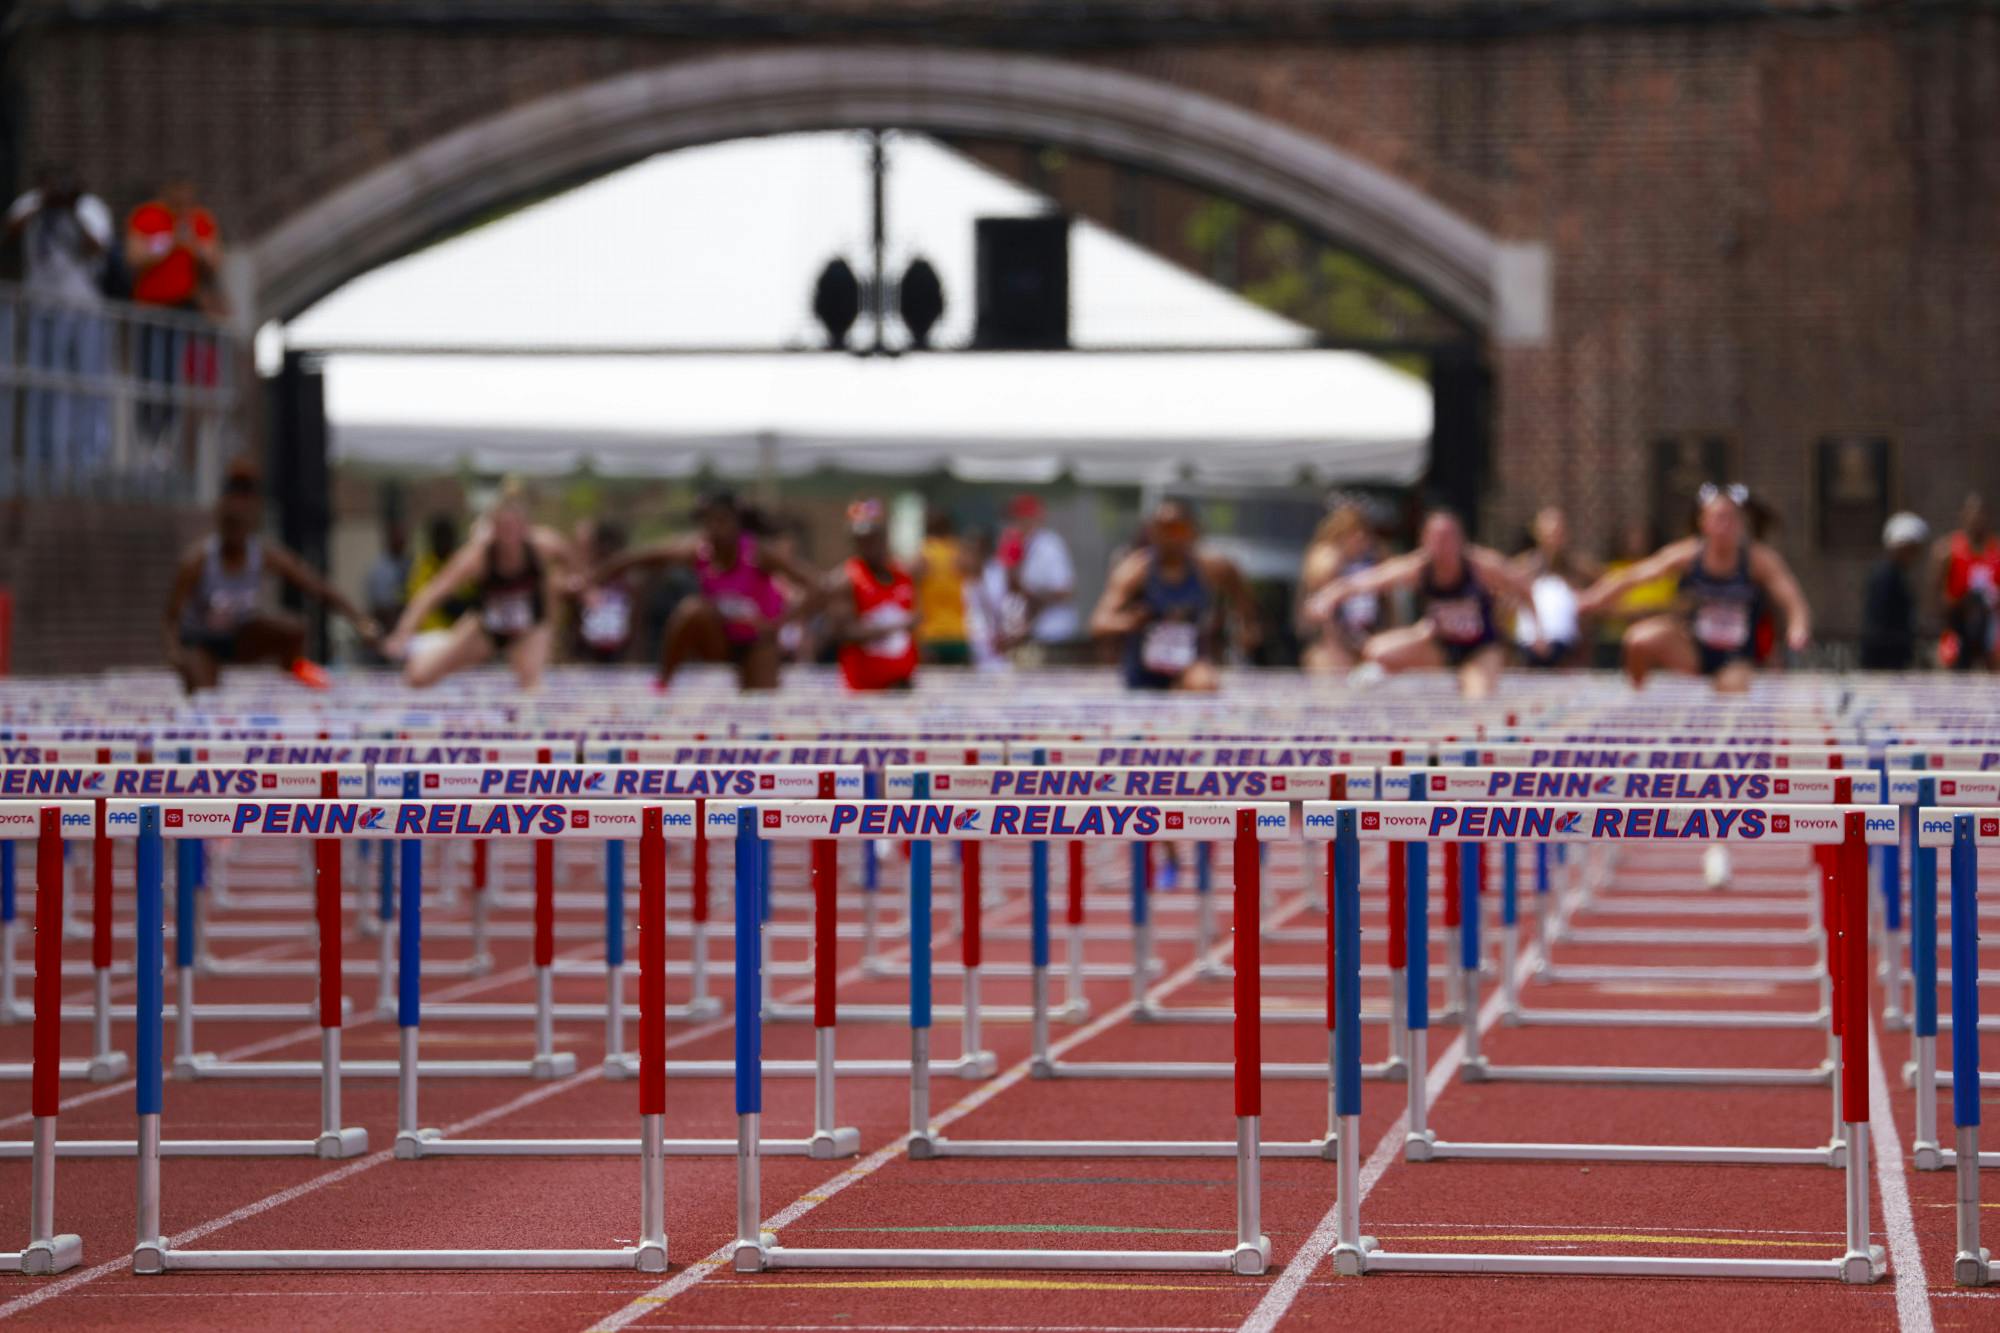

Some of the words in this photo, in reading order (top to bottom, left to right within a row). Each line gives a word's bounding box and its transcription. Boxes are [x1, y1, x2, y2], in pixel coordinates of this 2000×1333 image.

[246, 747, 333, 764] PENN
[362, 747, 481, 764] RELAYS
[673, 748, 762, 764] PENN
[790, 748, 909, 765] RELAYS
[1097, 748, 1185, 766] PENN
[1213, 748, 1334, 766] RELAYS
[1531, 750, 1620, 767] PENN
[1649, 751, 1771, 769] RELAYS
[0, 769, 83, 794] ENN
[112, 769, 258, 795] RELAYS
[280, 777, 316, 785] TOYOTA
[442, 777, 479, 786] TOYOTA
[479, 769, 584, 795] PENN
[613, 770, 756, 795] RELAYS
[779, 777, 814, 786] TOYOTA
[989, 771, 1094, 796] PENN
[1124, 771, 1267, 797] RELAYS
[1450, 779, 1486, 788] TOYOTA
[1486, 772, 1593, 798] PENN
[1624, 773, 1770, 799] RELAYS
[1793, 783, 1829, 791] TOYOTA
[1960, 784, 1996, 793] TOYOTA
[188, 813, 231, 823] TOYOTA
[231, 804, 359, 834] PENN
[394, 804, 567, 834] RELAYS
[594, 815, 637, 824] TOYOTA
[784, 815, 828, 824] TOYOTA
[829, 805, 954, 834] PENN
[990, 805, 1161, 835] RELAYS
[1187, 816, 1231, 825] TOYOTA
[1383, 816, 1427, 826] TOYOTA
[1428, 807, 1555, 837] PENN
[1591, 808, 1767, 839] RELAYS
[1794, 820, 1839, 829] TOYOTA
